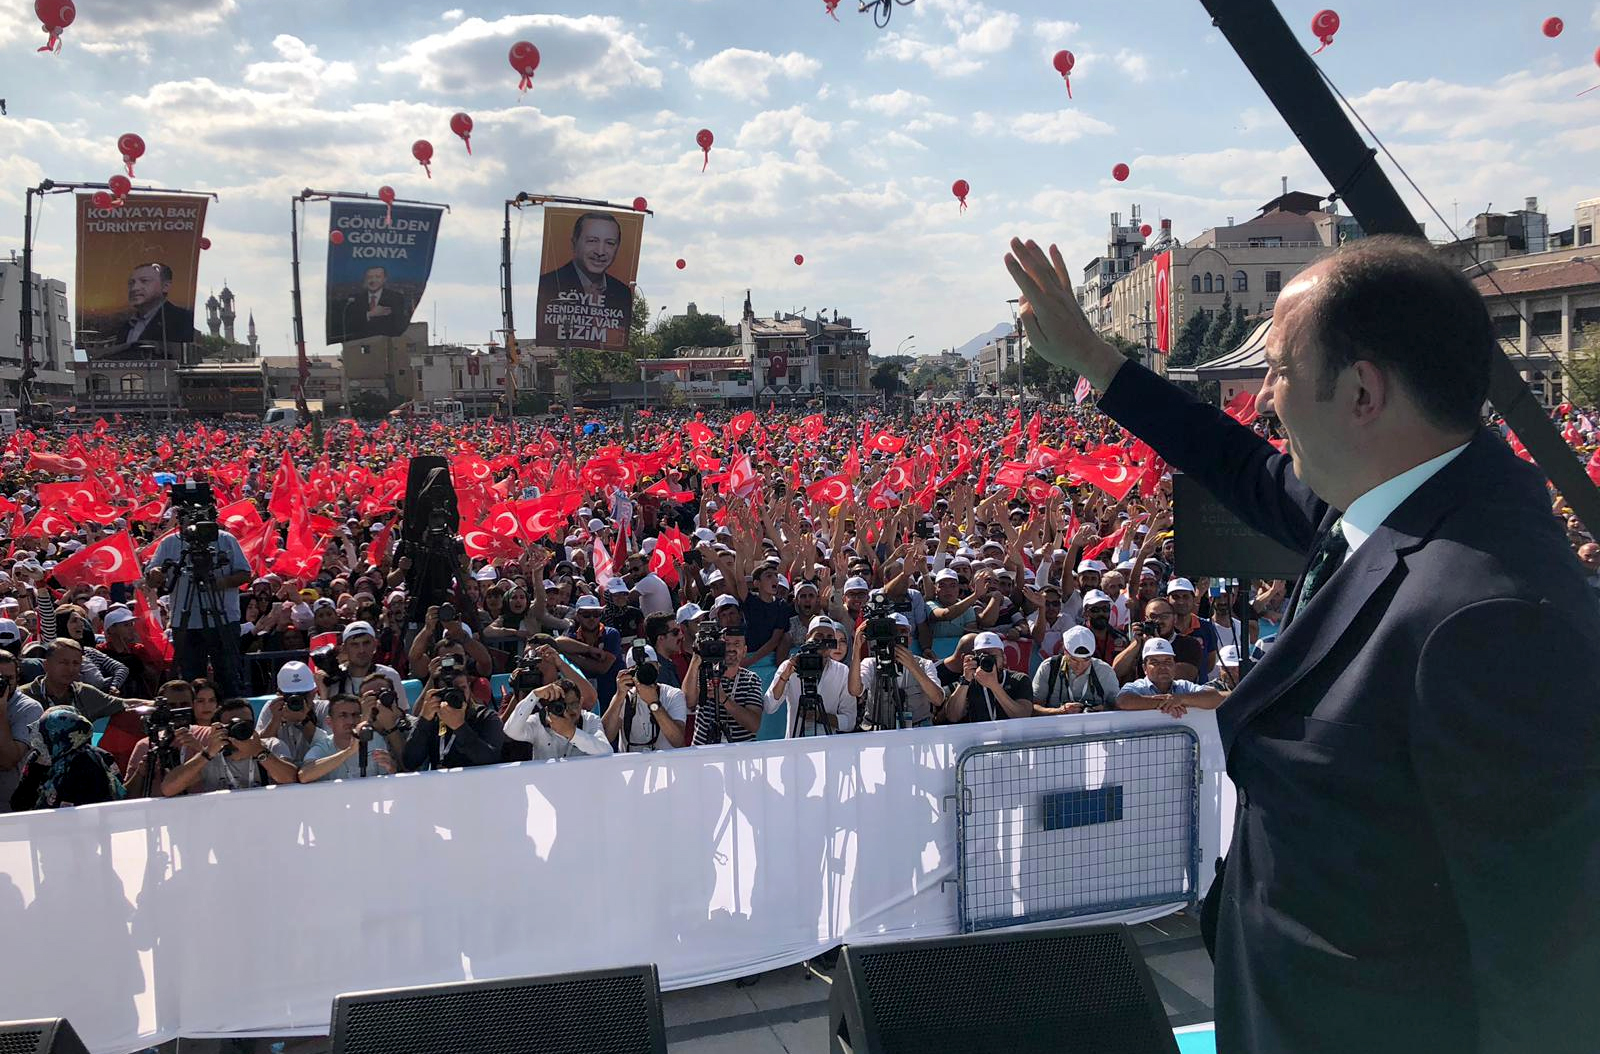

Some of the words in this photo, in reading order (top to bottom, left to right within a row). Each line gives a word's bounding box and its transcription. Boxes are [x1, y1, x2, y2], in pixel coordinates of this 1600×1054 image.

[87, 207, 164, 218] KONYA'YA
[166, 208, 197, 219] BAK
[87, 219, 161, 232] TÜRKİYE'Yİ
[163, 219, 194, 231] GÖR
[347, 229, 416, 245] GÖNÜLE
[352, 247, 408, 259] KONYA
[558, 290, 606, 307] SÖYLE
[546, 304, 588, 315] SENDEN
[590, 308, 624, 319] BAŞKA
[594, 316, 619, 329] VAR
[557, 324, 606, 343] BİZİM
